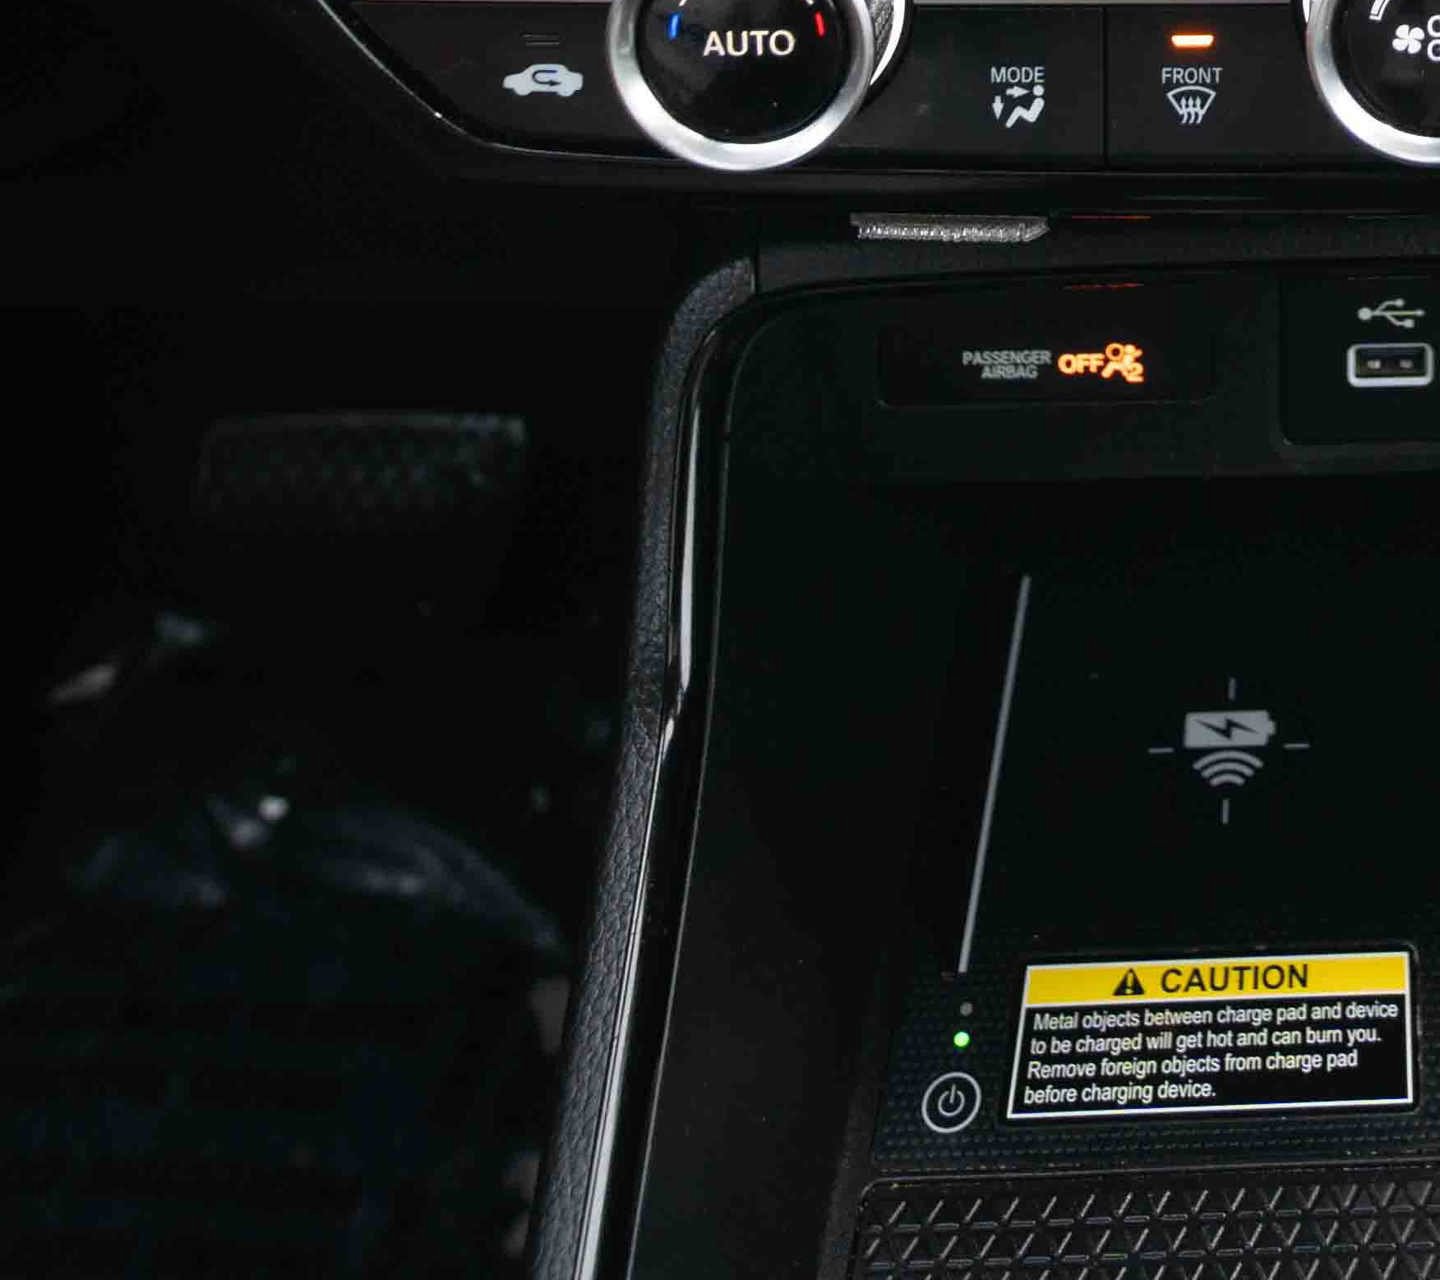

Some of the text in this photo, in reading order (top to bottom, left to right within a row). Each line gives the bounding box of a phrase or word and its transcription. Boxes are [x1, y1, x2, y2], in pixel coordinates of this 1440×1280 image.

[703, 30, 796, 59] AUTO
[990, 66, 1045, 85] MODE
[1161, 67, 1224, 85] FRONT
[962, 349, 1053, 367] PASSENGER
[980, 363, 1039, 380] AIRBAG
[1057, 352, 1106, 375] OFF
[1160, 963, 1309, 994] CAUTION
[1033, 1000, 1399, 1032] Metal objects between charge pad and device
[1030, 1026, 1382, 1056] to be charged will get hot and can burn you.
[1027, 1048, 1359, 1080] Remove foreign objects from charge pad
[1024, 1079, 1216, 1106] before charging device.
